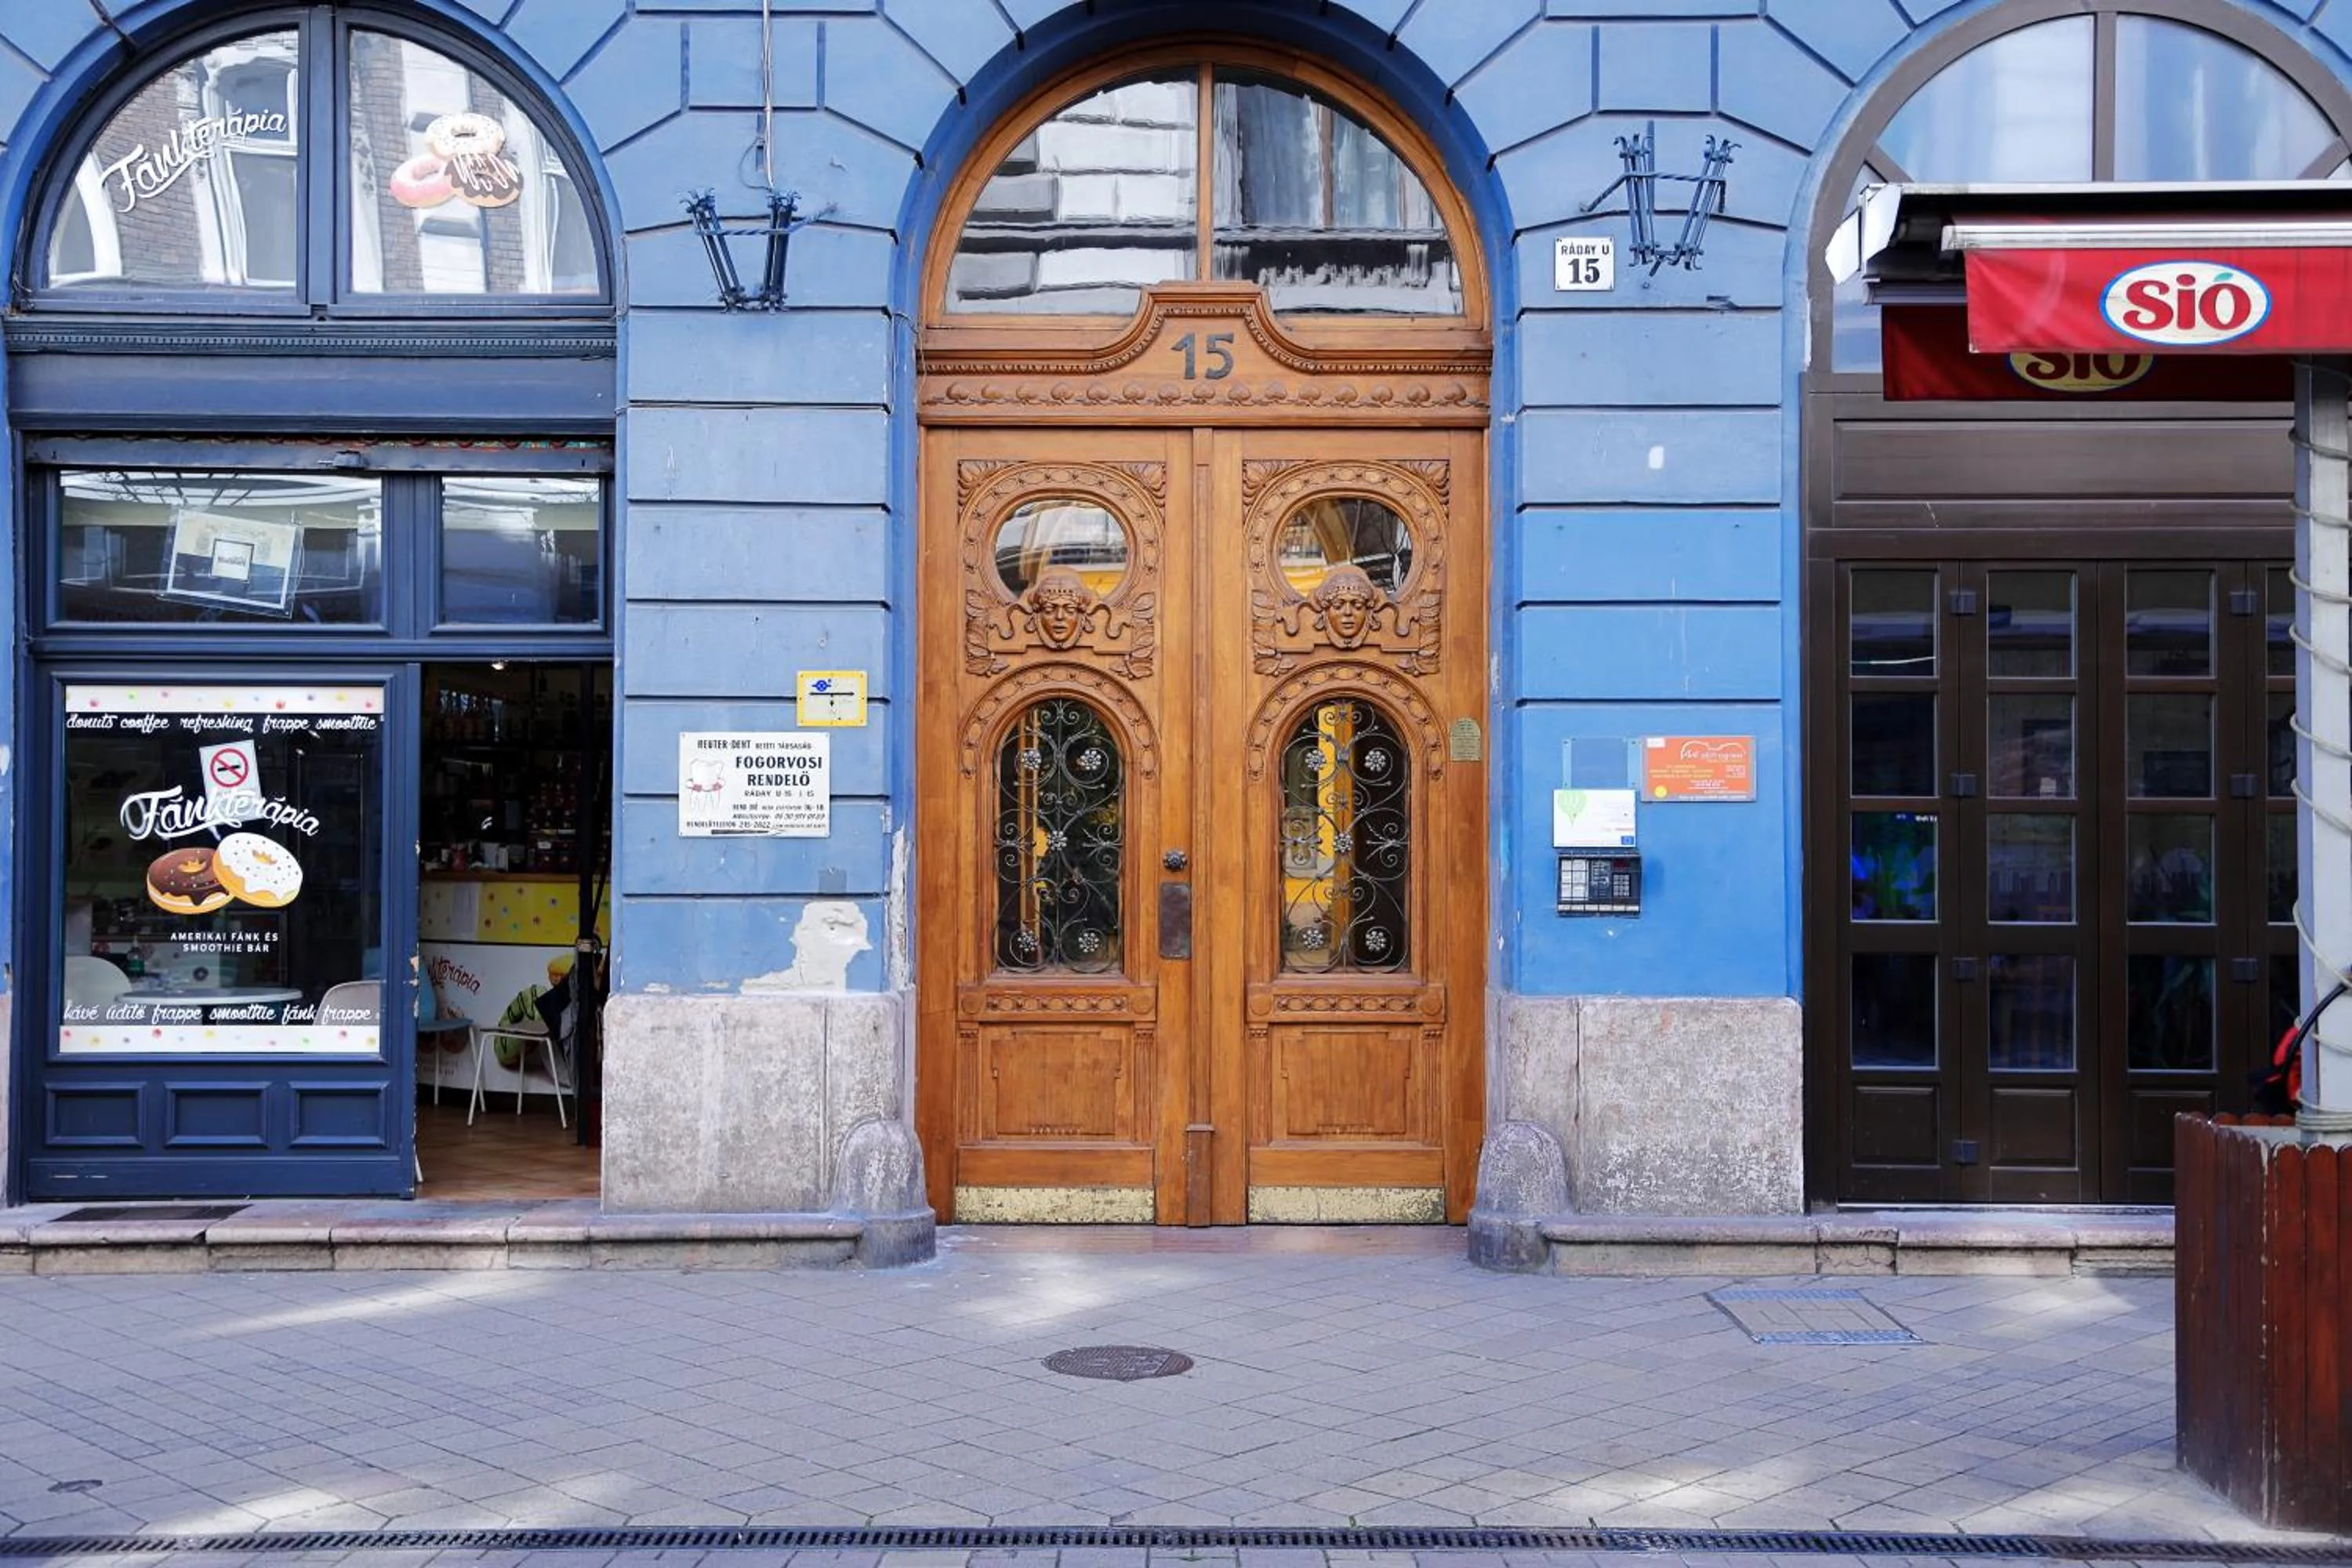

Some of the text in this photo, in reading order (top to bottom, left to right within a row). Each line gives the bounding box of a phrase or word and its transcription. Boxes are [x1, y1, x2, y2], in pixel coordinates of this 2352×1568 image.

[102, 107, 287, 213] Fánkterápia
[1561, 241, 1610, 256] RÁDAY U
[1568, 258, 1601, 285] 15
[1171, 332, 1234, 380] 15
[66, 714, 118, 729] donuts
[262, 714, 310, 735] frappe
[315, 714, 377, 730] smoothie
[735, 756, 823, 770] FOGORVOSI
[120, 785, 320, 841] Fánkterápia
[170, 931, 279, 942] AMERIKAI FÁNK ÉS
[183, 942, 270, 953] SMOOTHIE BÁR
[64, 1004, 100, 1020] kávé
[151, 1004, 203, 1025] frappe
[209, 1004, 276, 1020] smoothie
[281, 1004, 317, 1025] fánk
[321, 1004, 371, 1025] frappe
